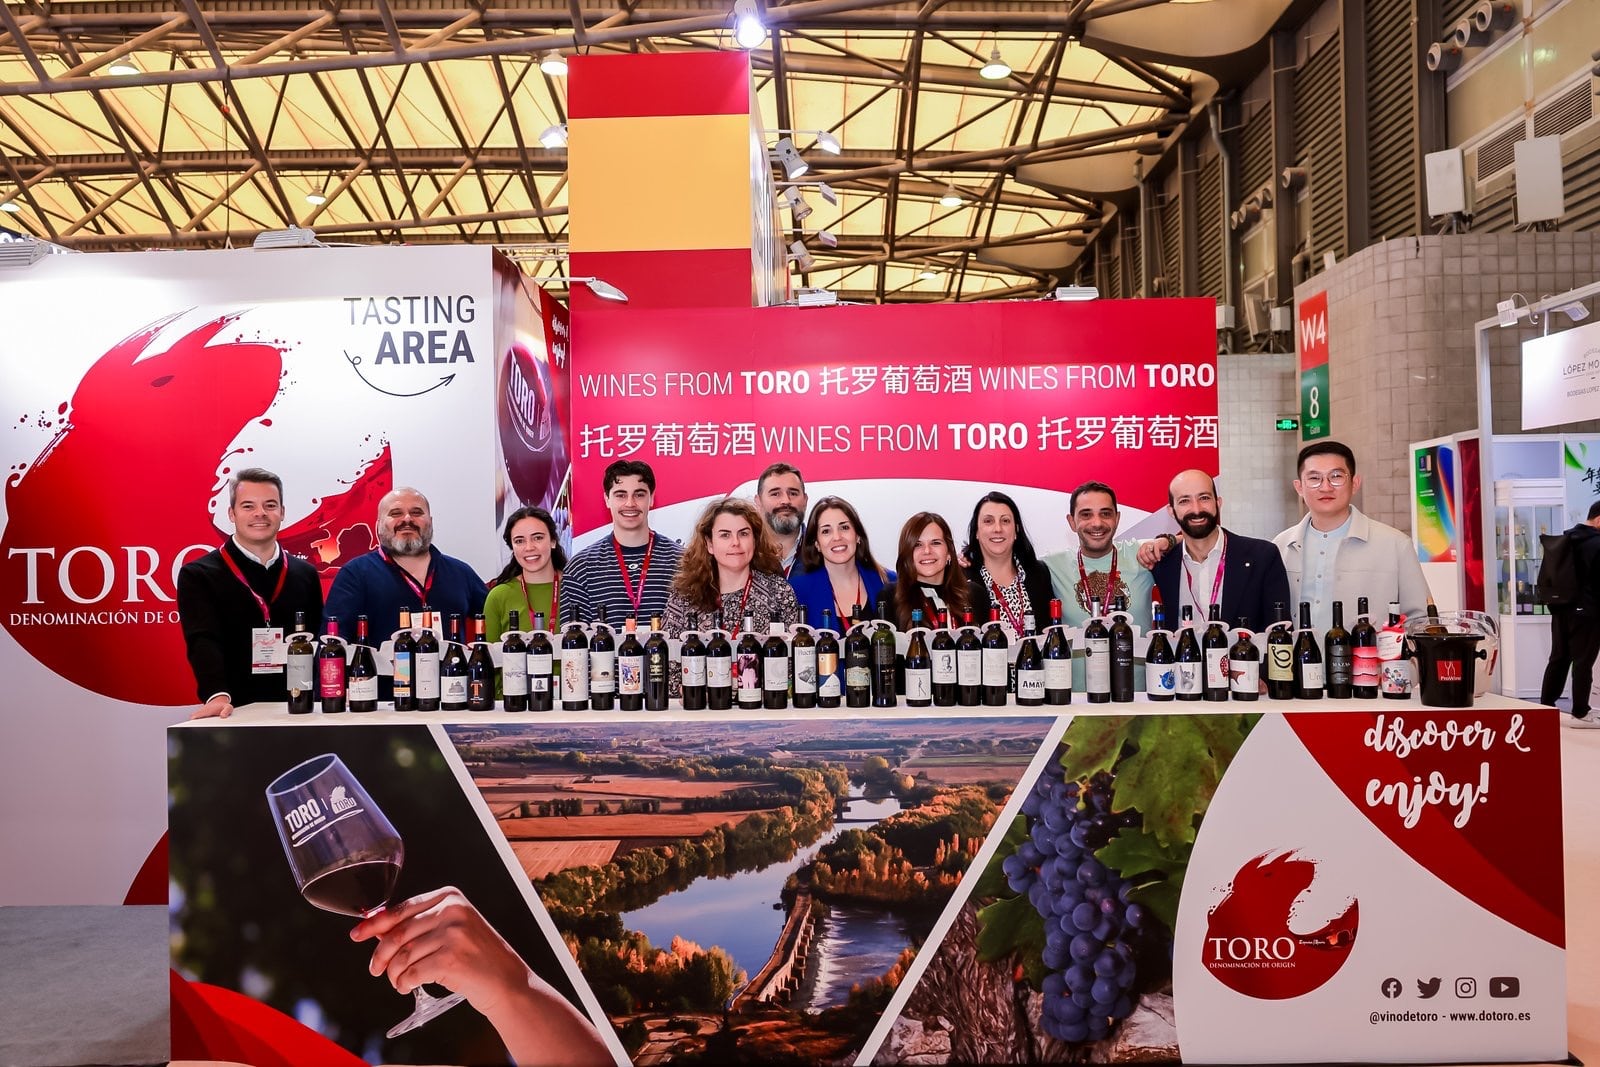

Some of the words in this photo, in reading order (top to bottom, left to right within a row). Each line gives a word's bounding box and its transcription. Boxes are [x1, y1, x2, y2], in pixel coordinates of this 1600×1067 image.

[343, 295, 475, 325] TASTING
[374, 330, 475, 365] AREA
[1301, 310, 1326, 352] W4
[510, 347, 535, 426] TORO
[579, 373, 657, 398] WINES
[665, 371, 732, 396] FROM
[741, 370, 810, 395] TORO
[819, 364, 972, 396] 托罗葡萄酒
[979, 365, 1058, 391] WINES
[1066, 364, 1135, 390] FROM
[1143, 363, 1215, 388] TORO
[1310, 386, 1320, 418] 8
[579, 422, 757, 459] 托罗葡萄酒
[761, 425, 851, 453] WINES
[861, 424, 938, 452] FROM
[948, 422, 1028, 450] TORO
[1037, 415, 1218, 451] 托罗葡萄酒
[10, 609, 139, 626] DENOMINACIÓN
[144, 611, 163, 624] DE
[1364, 714, 1496, 758] discover
[1504, 714, 1531, 752] &
[1365, 762, 1490, 829] enjoy!
[285, 798, 321, 833] TORO
[1208, 937, 1295, 960] TORO
[1369, 1011, 1438, 1024] @vinodetoro
[1450, 1010, 1531, 1022] www.dotoro.es
